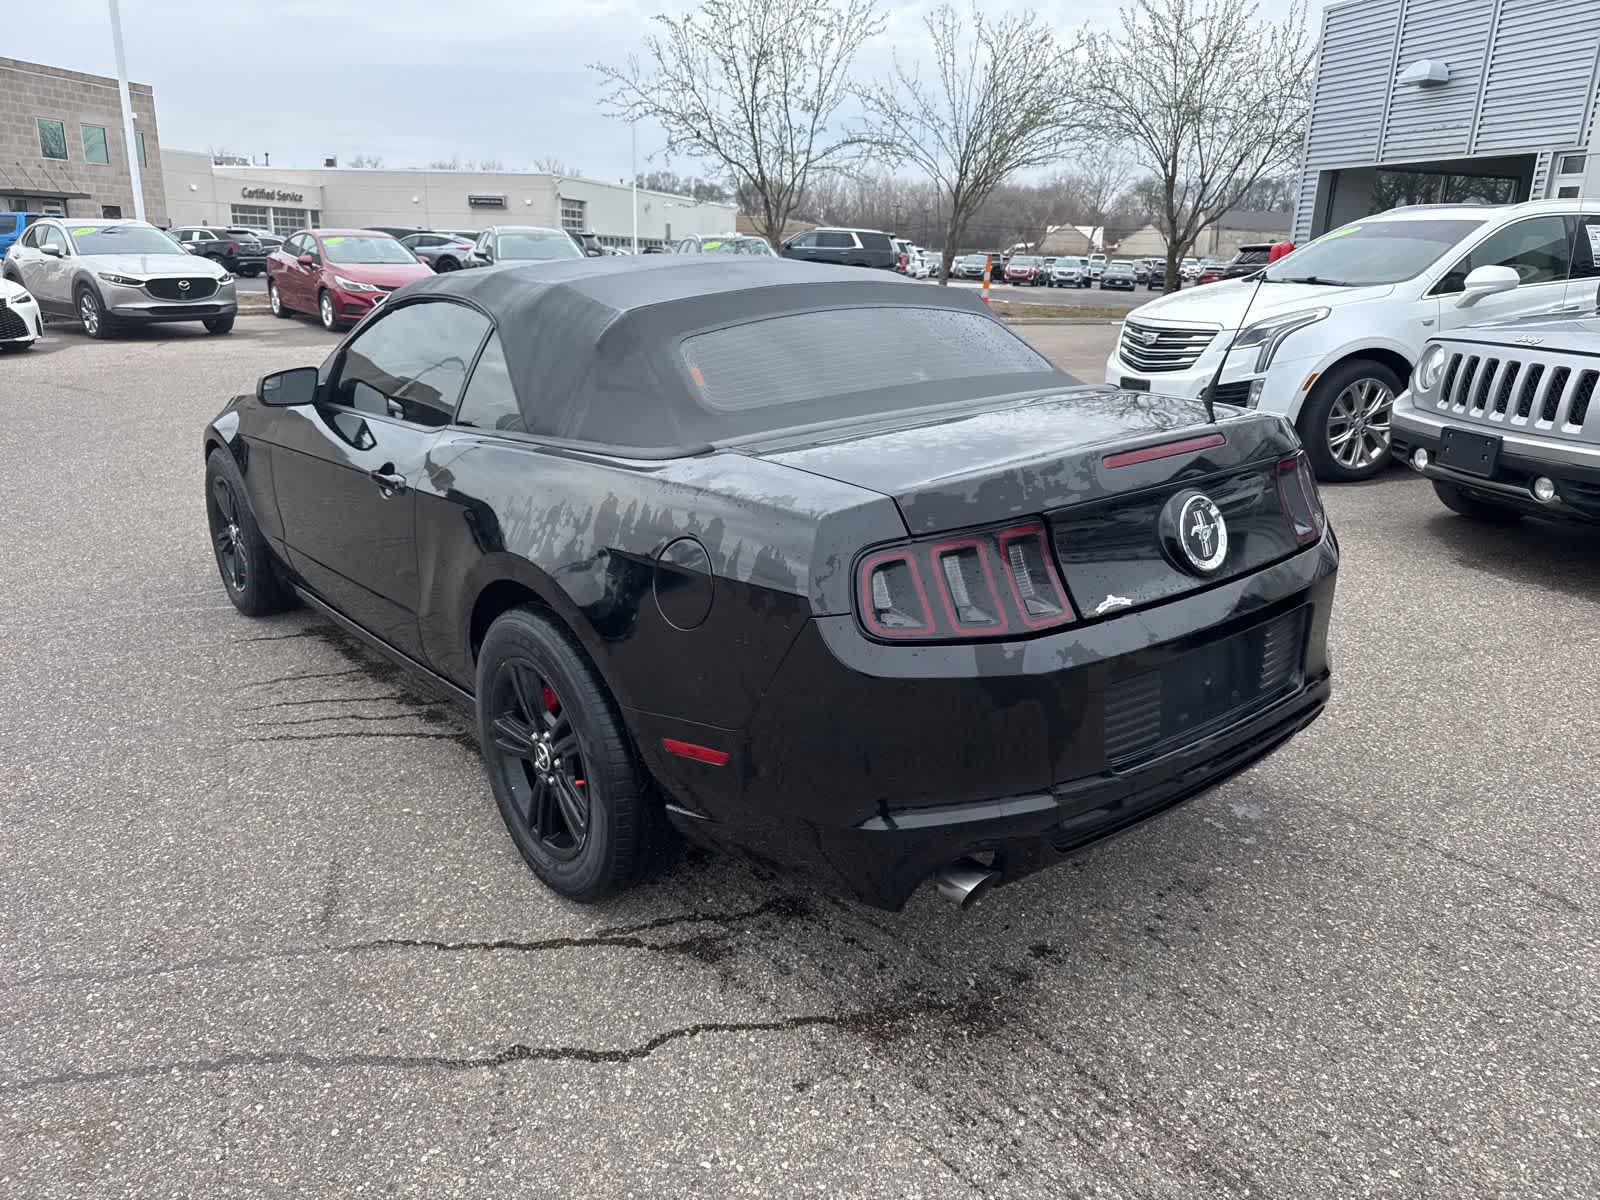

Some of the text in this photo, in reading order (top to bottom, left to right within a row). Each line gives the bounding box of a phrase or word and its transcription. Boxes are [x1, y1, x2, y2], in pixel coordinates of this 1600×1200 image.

[241, 187, 303, 202] Certified Service
[1515, 334, 1545, 346] Jeep
